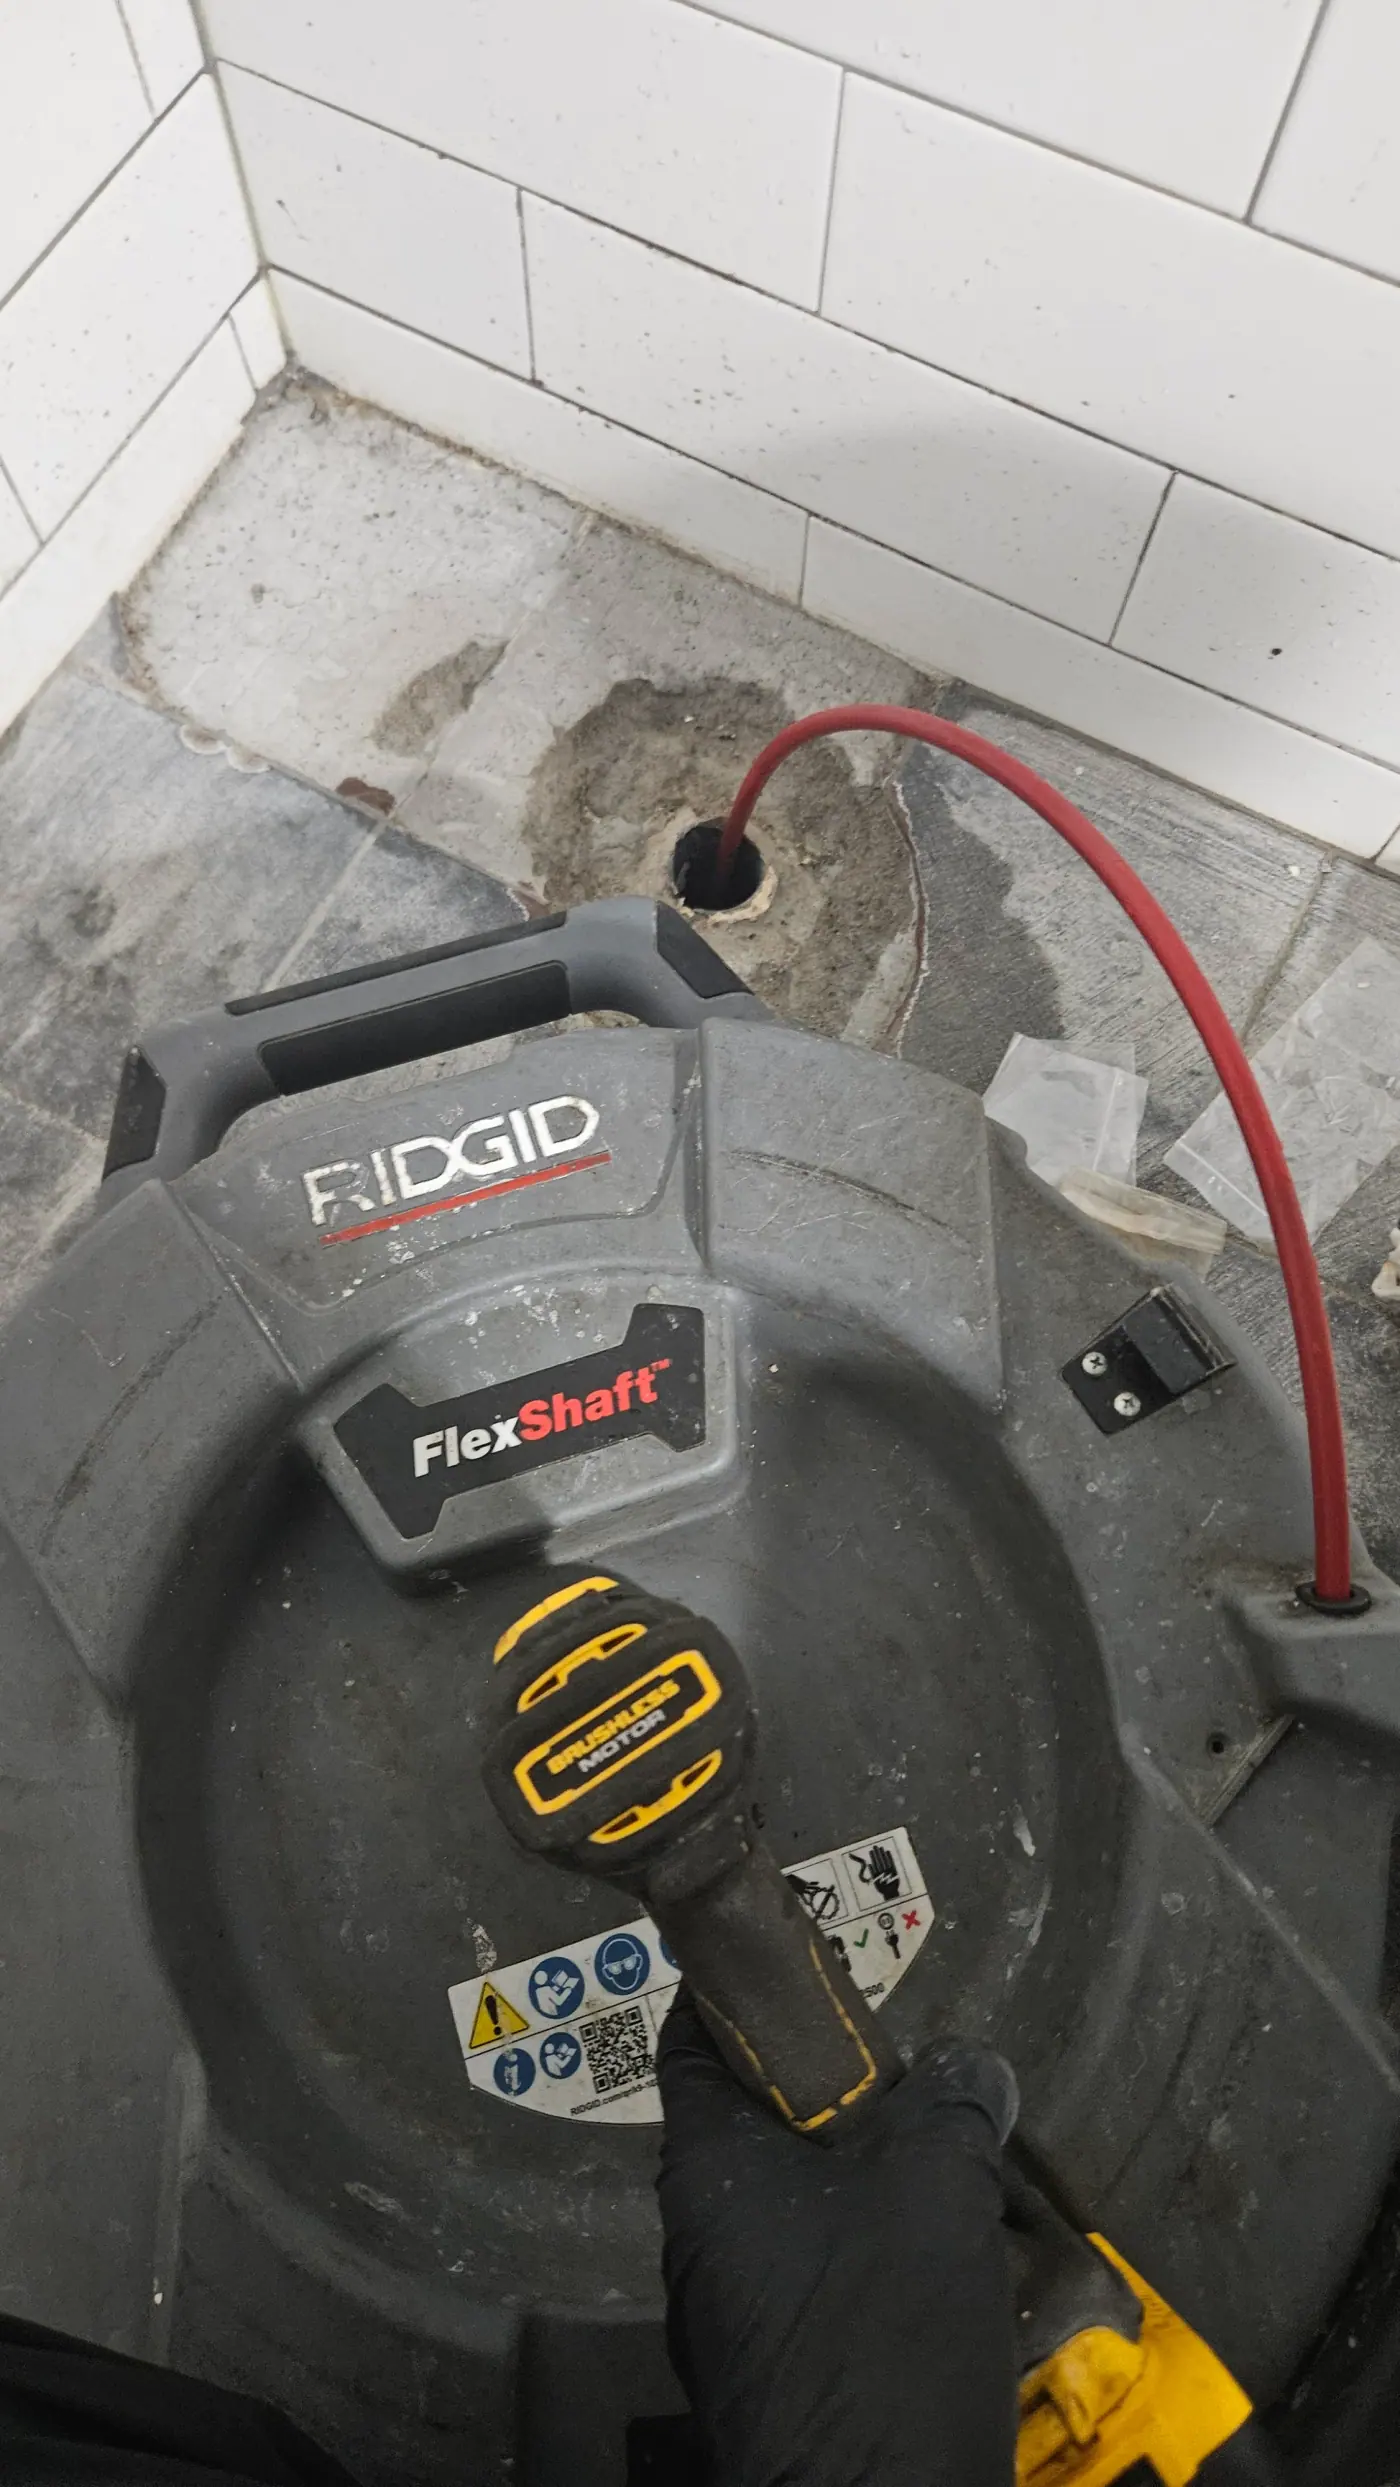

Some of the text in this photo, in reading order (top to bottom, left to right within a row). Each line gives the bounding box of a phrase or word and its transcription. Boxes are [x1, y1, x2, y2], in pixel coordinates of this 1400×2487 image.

[303, 1095, 600, 1226] RIDGID
[547, 1680, 680, 1774] BRUSHLESS
[578, 1709, 666, 1772] MOTOR
